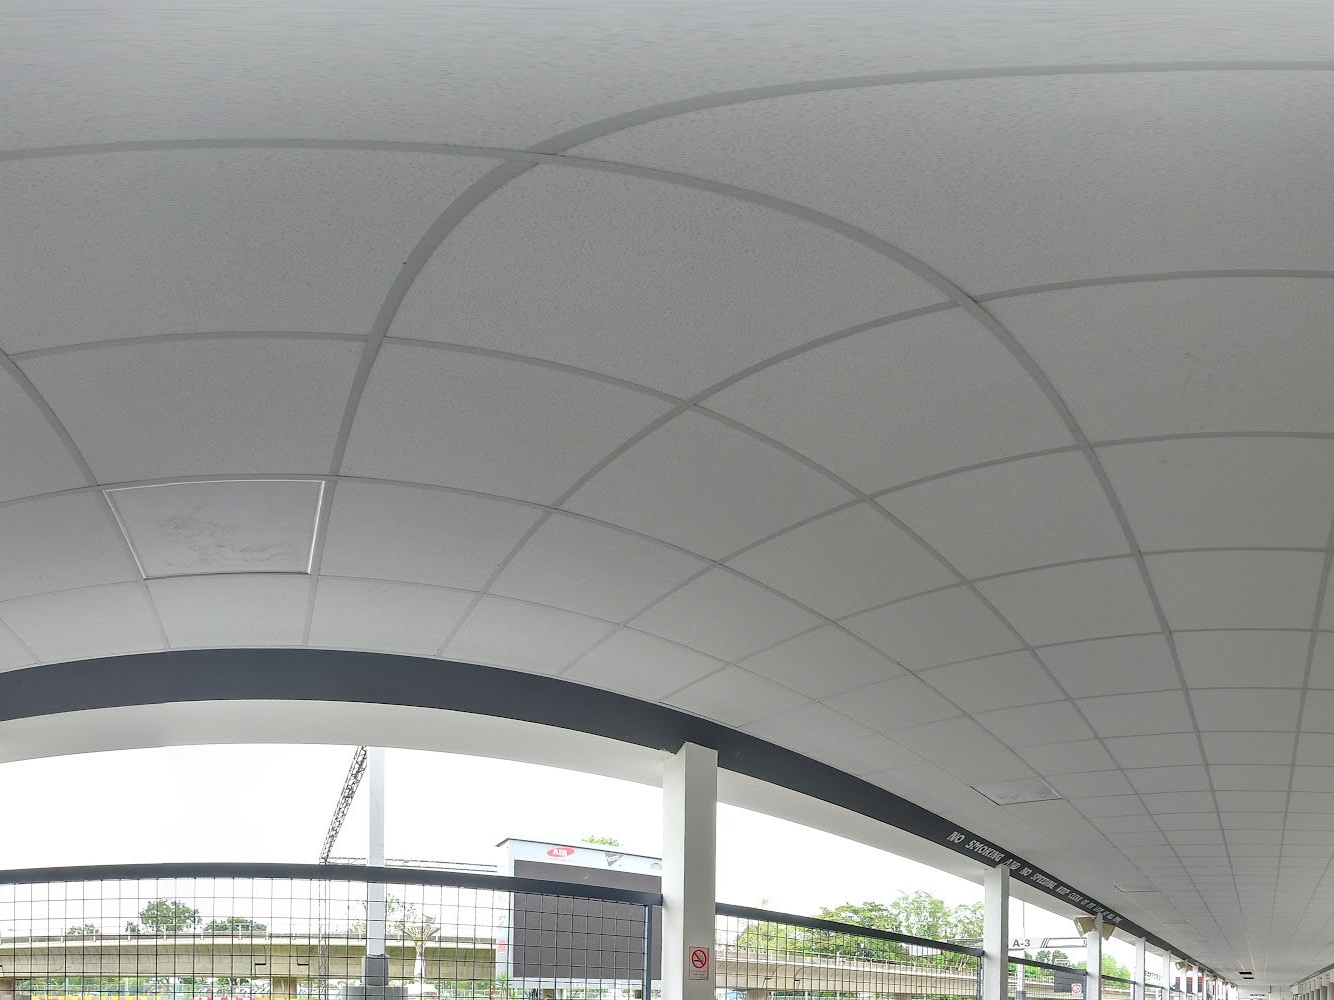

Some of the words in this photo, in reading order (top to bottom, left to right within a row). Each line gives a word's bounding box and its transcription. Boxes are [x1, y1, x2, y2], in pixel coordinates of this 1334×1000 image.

[947, 831, 965, 843] NO
[965, 840, 1005, 861] SMOKING
[1003, 859, 1021, 870] AND
[1019, 867, 1032, 876] NO
[1030, 873, 1058, 889] SPEEDING
[1012, 939, 1031, 947] A-3
